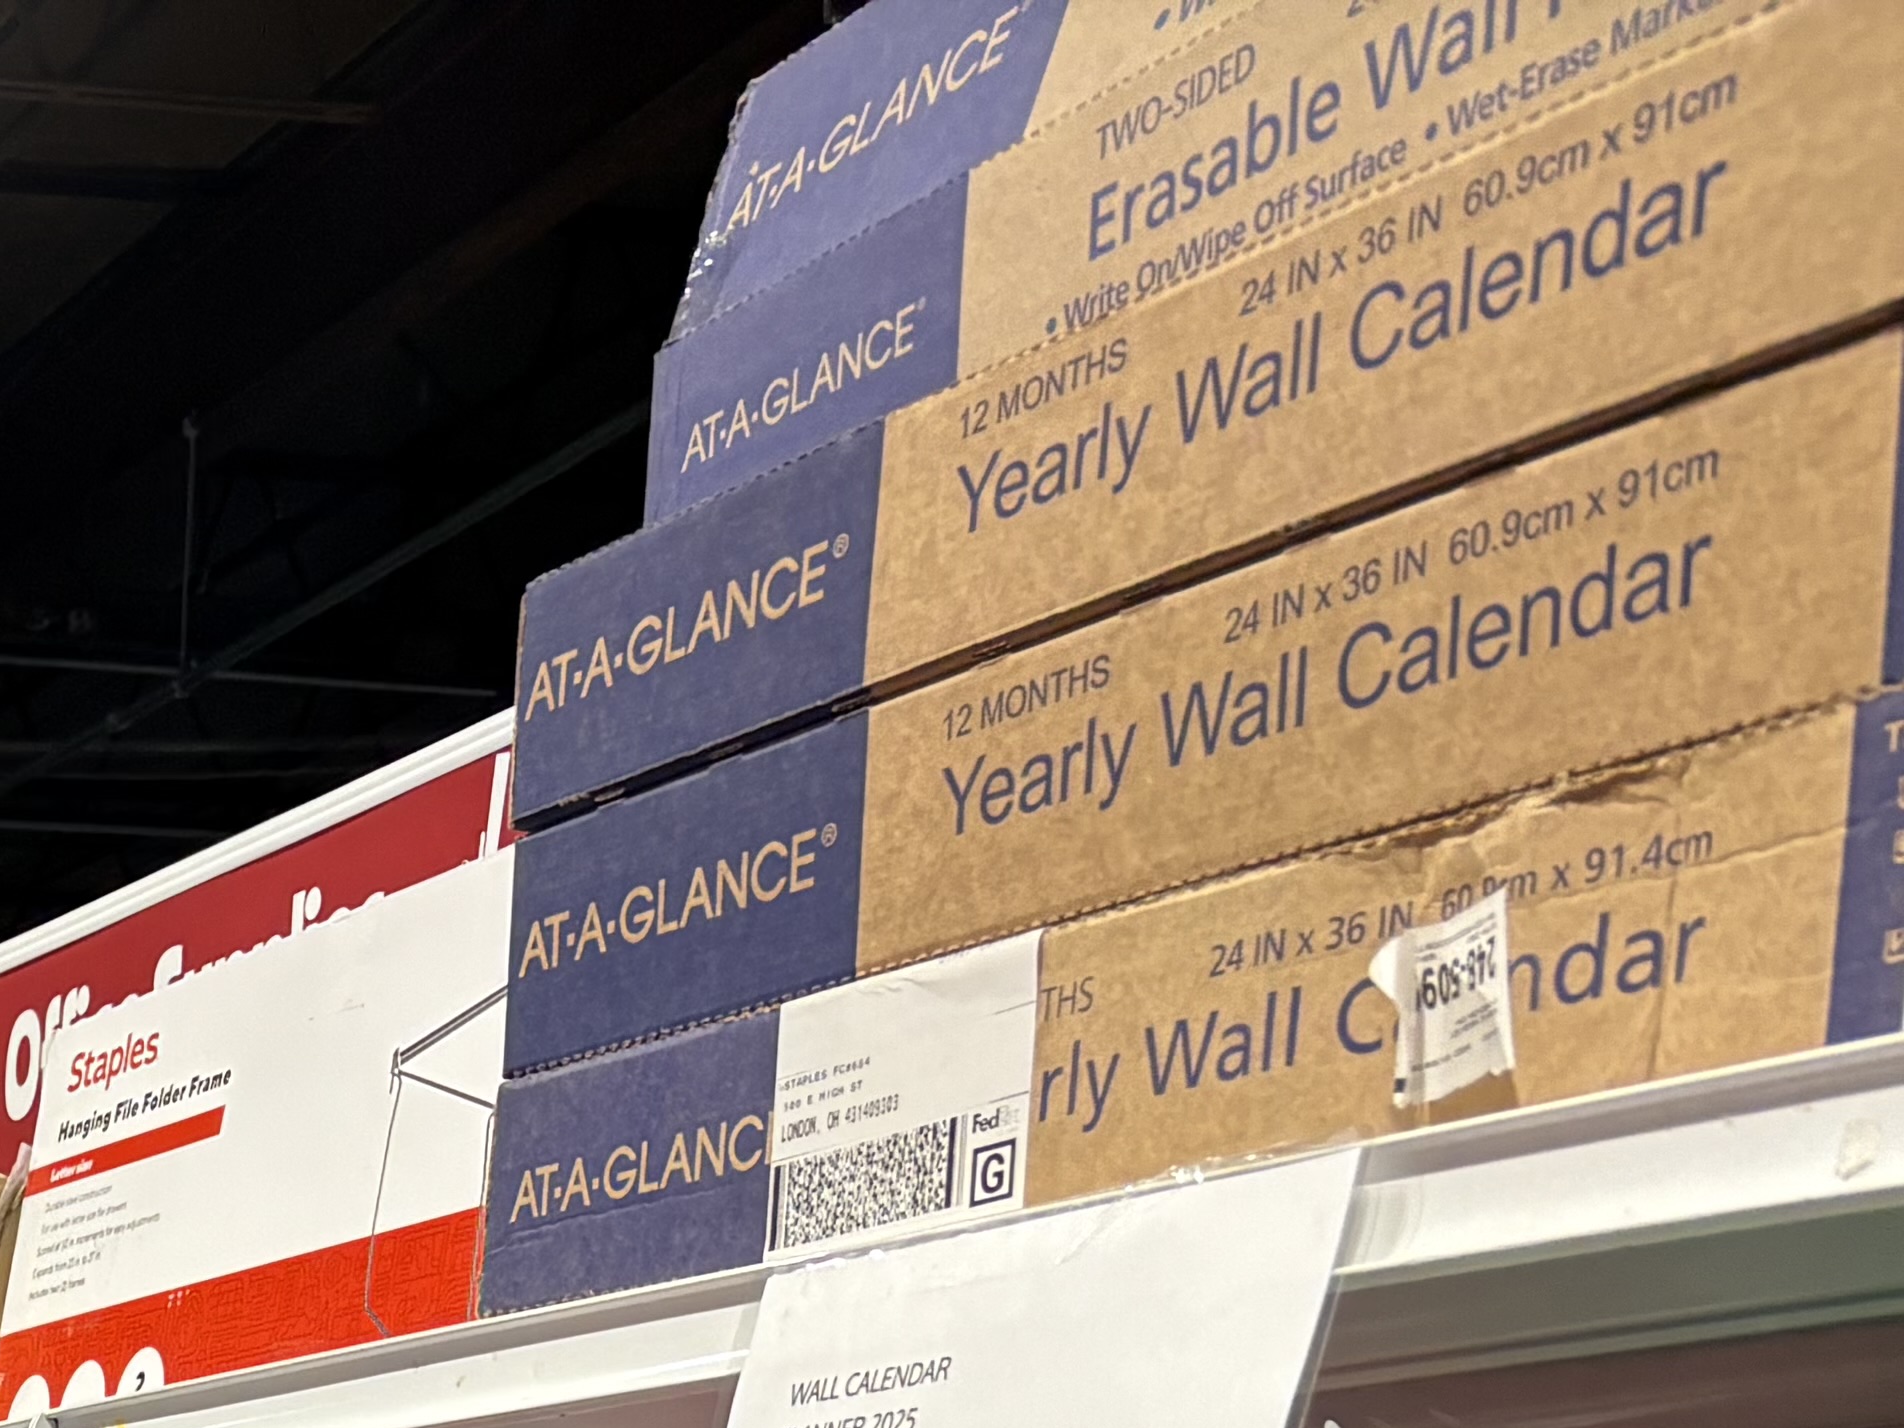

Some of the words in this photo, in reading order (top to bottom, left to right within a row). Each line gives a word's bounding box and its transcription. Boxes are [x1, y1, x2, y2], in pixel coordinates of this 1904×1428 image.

[1096, 44, 1256, 160] TWO-SIDED
[1064, 278, 1130, 328] Write
[1136, 218, 1246, 296] On/Wipe
[1254, 184, 1302, 233] Off
[1305, 136, 1407, 210] Surface
[1446, 35, 1601, 136] Wet-Erase
[1089, 76, 1341, 262] Erasable
[1239, 273, 1276, 318] 24
[1288, 257, 1319, 295] IN
[1357, 217, 1397, 264] 36
[1408, 195, 1442, 243] IN
[1462, 135, 1590, 217] 60.9cm
[1632, 73, 1738, 143] 91cm
[957, 402, 1152, 533] Yearly
[1176, 312, 1322, 444] Wall
[1349, 161, 1729, 370] Calendar
[961, 402, 989, 439] 12
[996, 338, 1128, 423] MONTHS
[1223, 606, 1260, 644] 24
[1271, 583, 1306, 627] IN
[1341, 561, 1382, 601] 36
[1392, 540, 1430, 584] IN
[1448, 496, 1575, 565] 60.9cm
[1618, 450, 1720, 511] 91cm
[942, 716, 1137, 836] Yearly
[1161, 645, 1308, 757] Wall
[1336, 534, 1713, 710] Calendar
[943, 708, 972, 741] 12
[980, 654, 1112, 732] MONTHS
[1209, 944, 1245, 978] 24
[1252, 928, 1287, 969] IN
[1325, 910, 1368, 951] 36
[1583, 829, 1715, 885] 91.4cm
[67, 1032, 160, 1093] Staples
[1146, 988, 1301, 1090] Wall
[58, 1111, 112, 1143] Hanging
[114, 1099, 138, 1123] File
[142, 1083, 186, 1114] Folder
[189, 1068, 232, 1098] Frame
[981, 1152, 1005, 1194] G
[791, 1371, 839, 1407] WALL
[844, 1356, 952, 1398] CALENDAR
